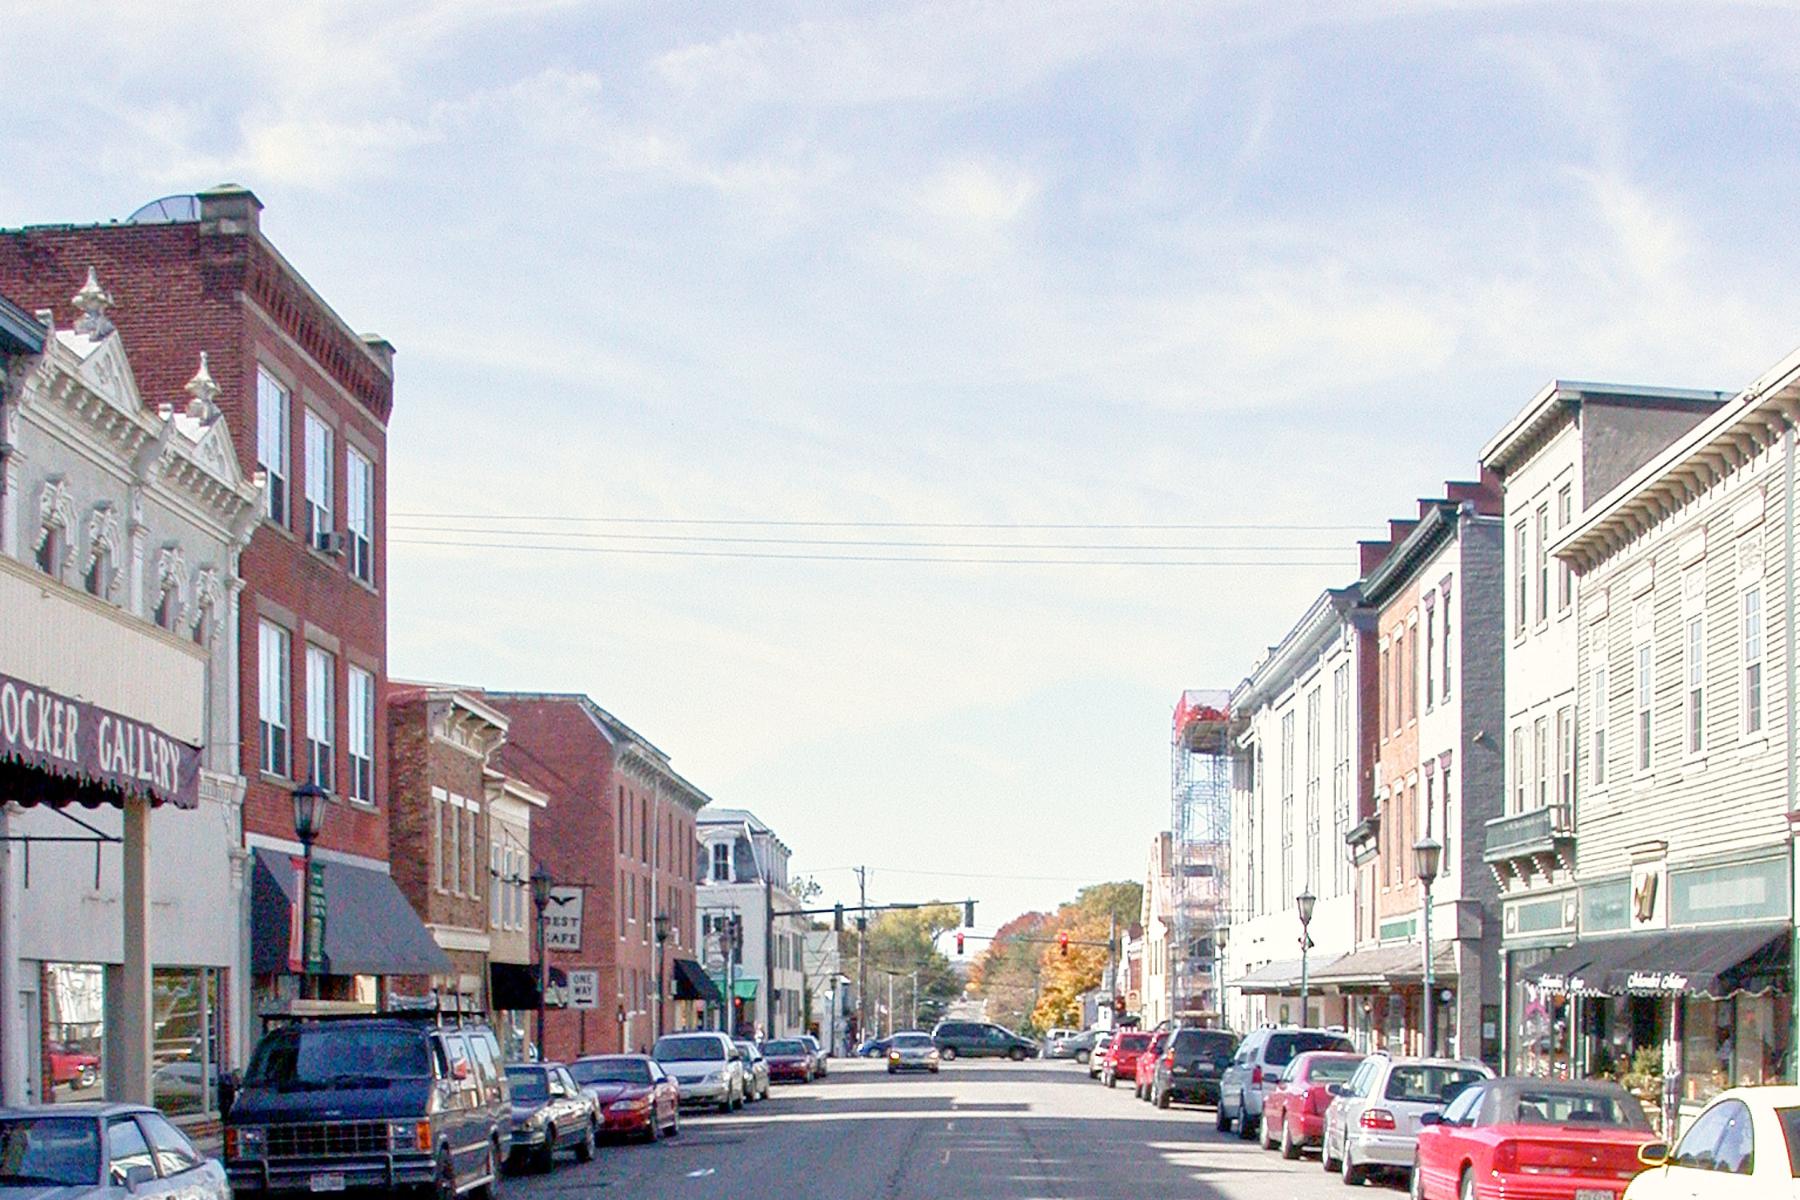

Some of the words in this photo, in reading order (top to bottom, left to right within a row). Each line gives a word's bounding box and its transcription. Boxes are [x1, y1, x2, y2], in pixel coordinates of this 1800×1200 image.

[0, 682, 78, 763] OCKER
[99, 716, 180, 794] GALLERY
[573, 974, 592, 985] ONE
[575, 986, 592, 995] WAY
